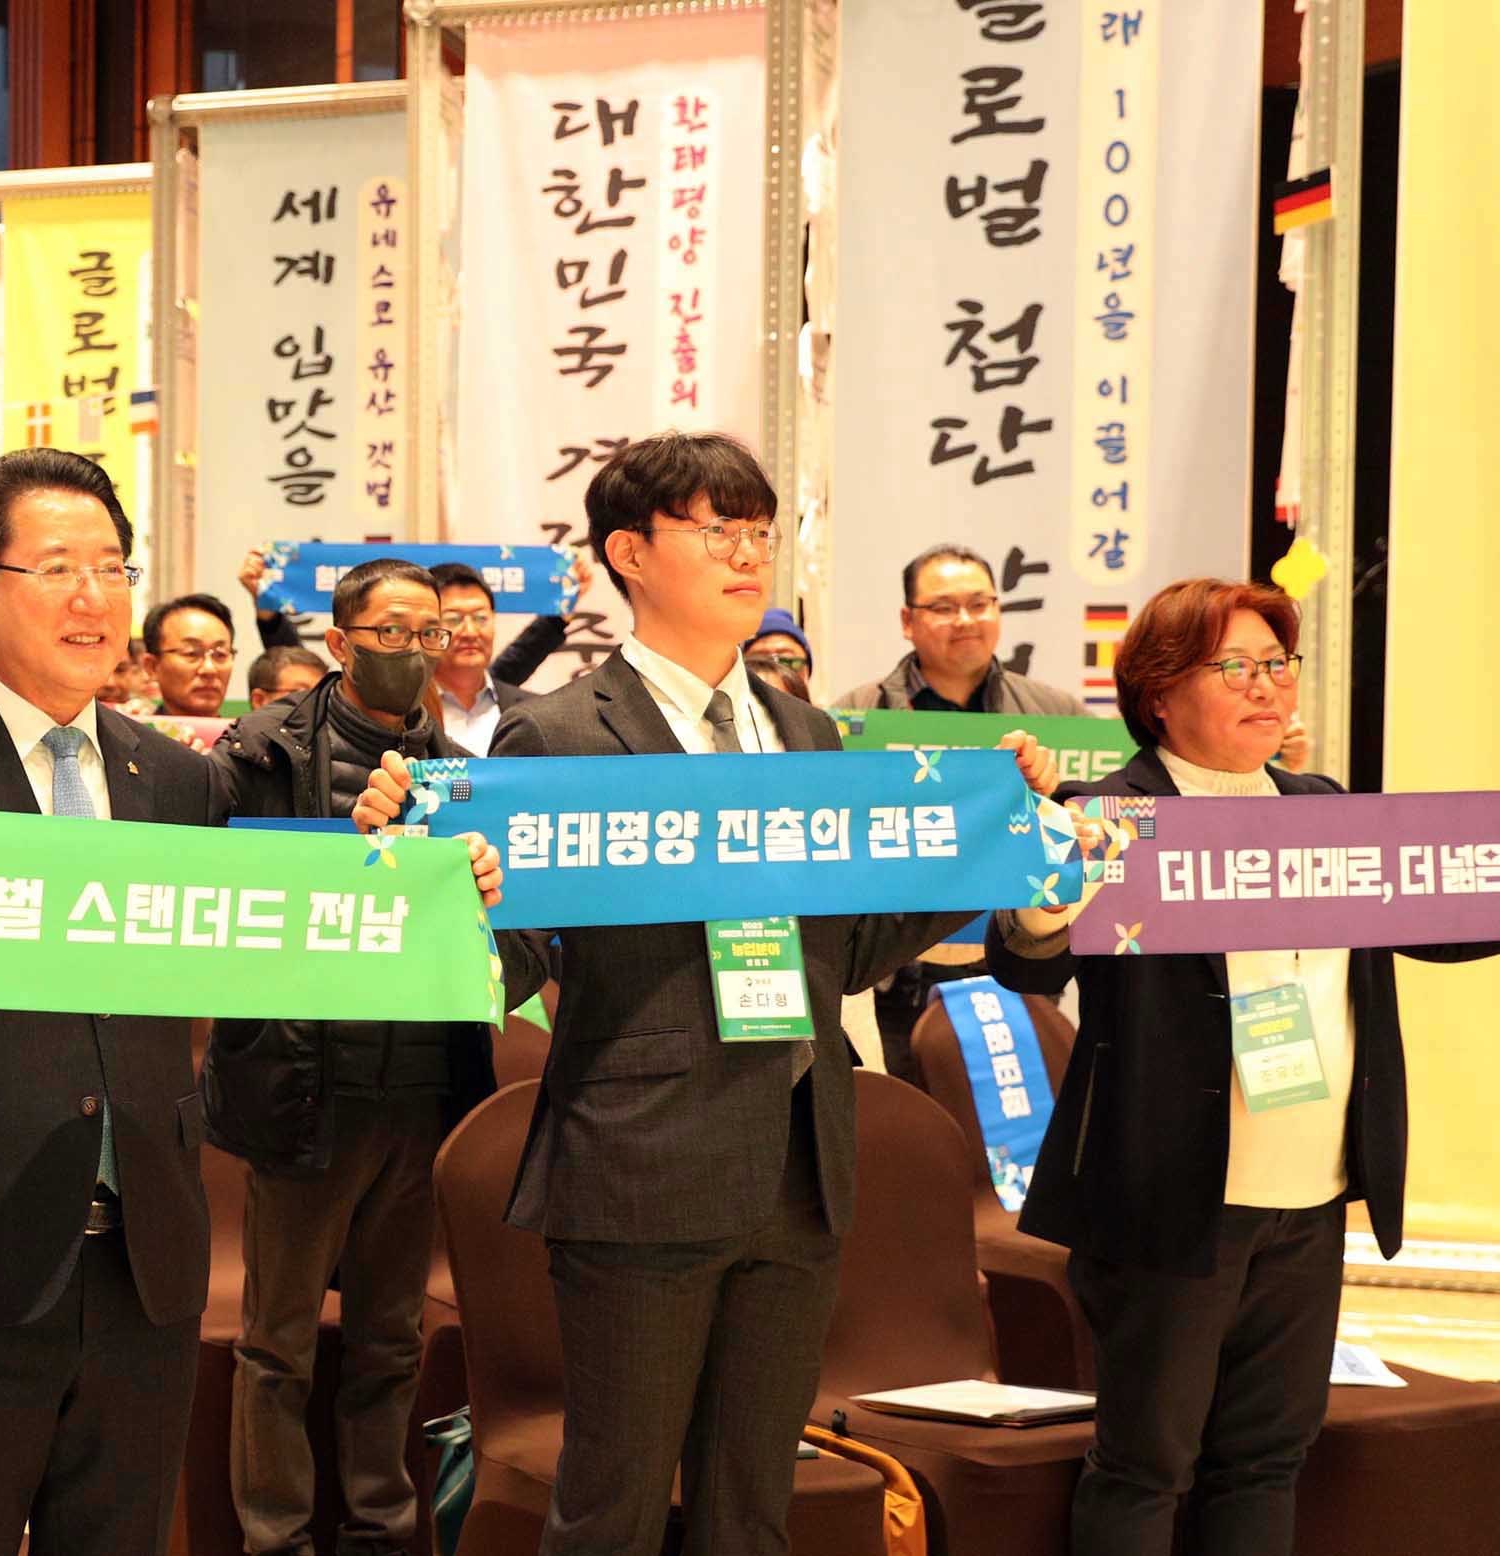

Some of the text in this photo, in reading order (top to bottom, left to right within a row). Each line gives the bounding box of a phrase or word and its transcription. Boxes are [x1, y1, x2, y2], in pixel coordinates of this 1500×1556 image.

[272, 186, 339, 287] 세계
[540, 97, 647, 388] 대한민국
[667, 94, 709, 410] 환태평양 진출의
[267, 325, 338, 506] 입맛을
[366, 347, 395, 416] 유산
[928, 299, 1053, 487] 첨단
[507, 804, 959, 869] 환태평양 진출의 관문
[1158, 842, 1500, 904] 더 나은 미래로, 더 넓은
[66, 880, 287, 951] 스탠더드
[306, 891, 410, 954] 전남
